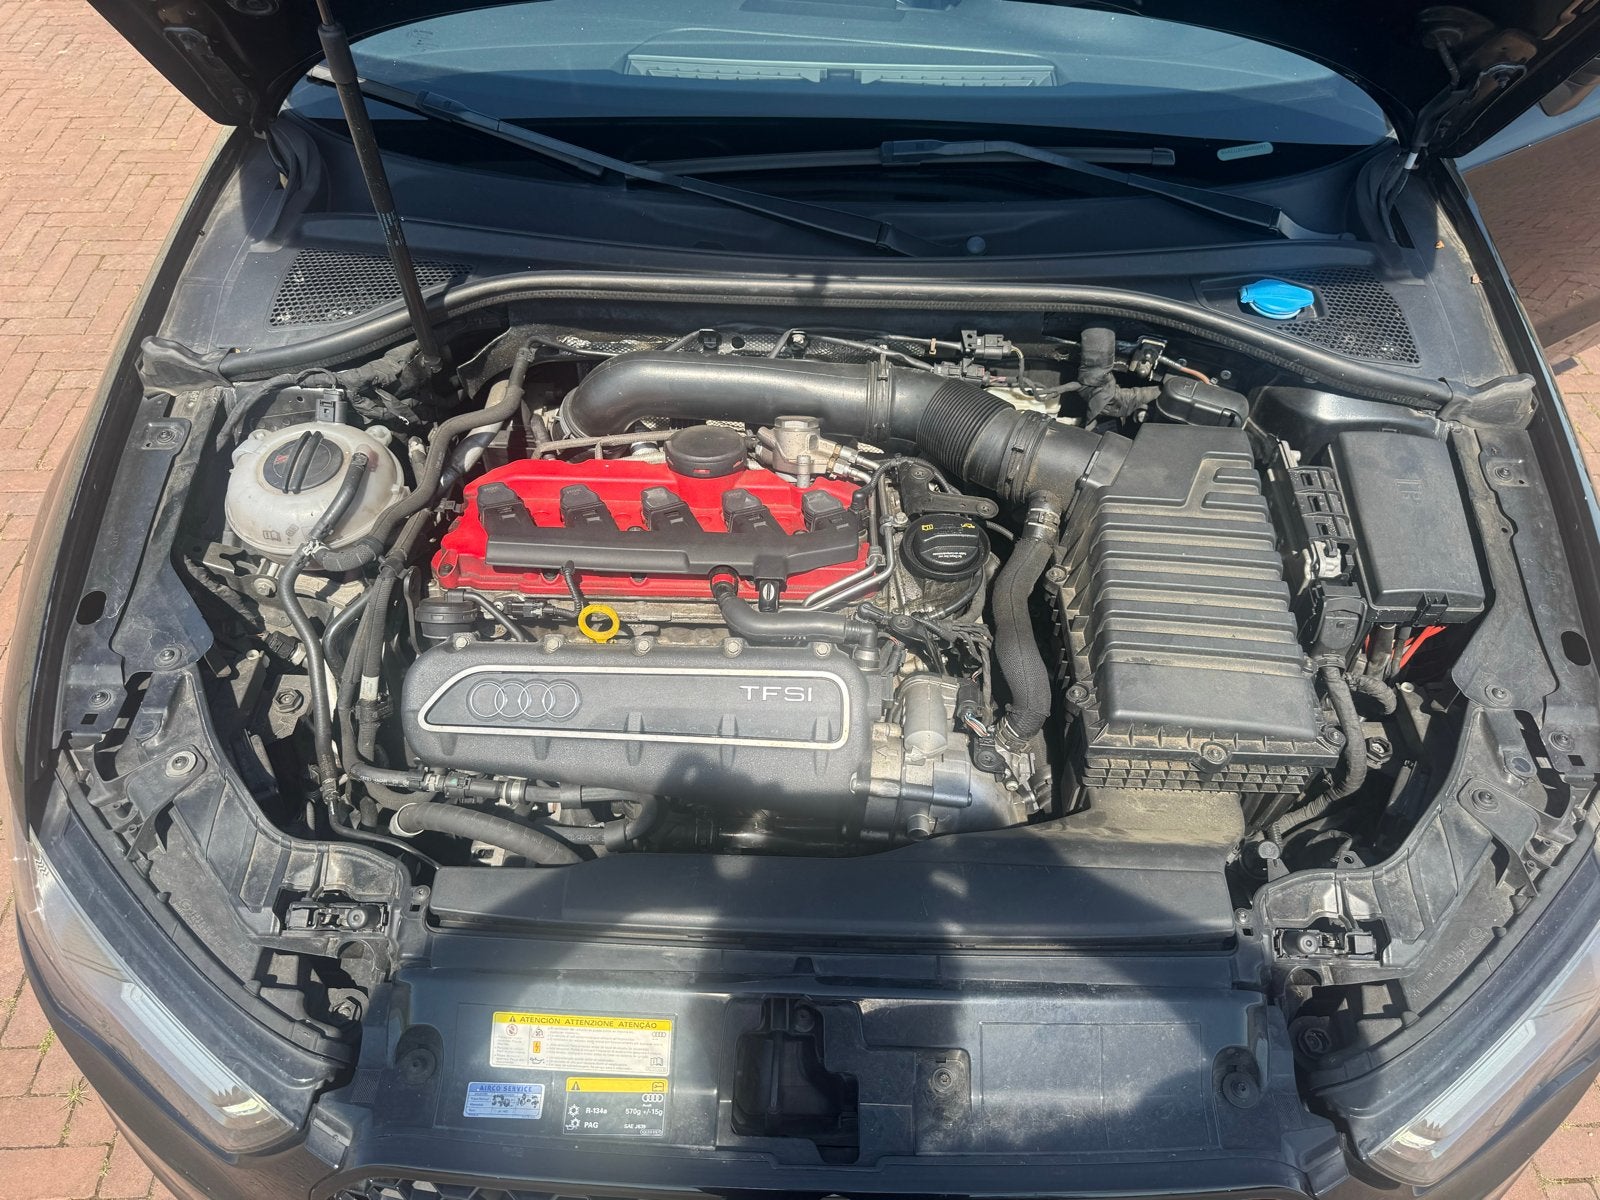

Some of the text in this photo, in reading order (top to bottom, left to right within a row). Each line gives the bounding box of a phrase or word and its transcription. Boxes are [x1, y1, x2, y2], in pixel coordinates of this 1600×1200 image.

[739, 685, 812, 702] TFSI
[564, 1018, 614, 1027] ATTENZIONE
[625, 1107, 642, 1116] 570g
[584, 1121, 599, 1129] PAG
